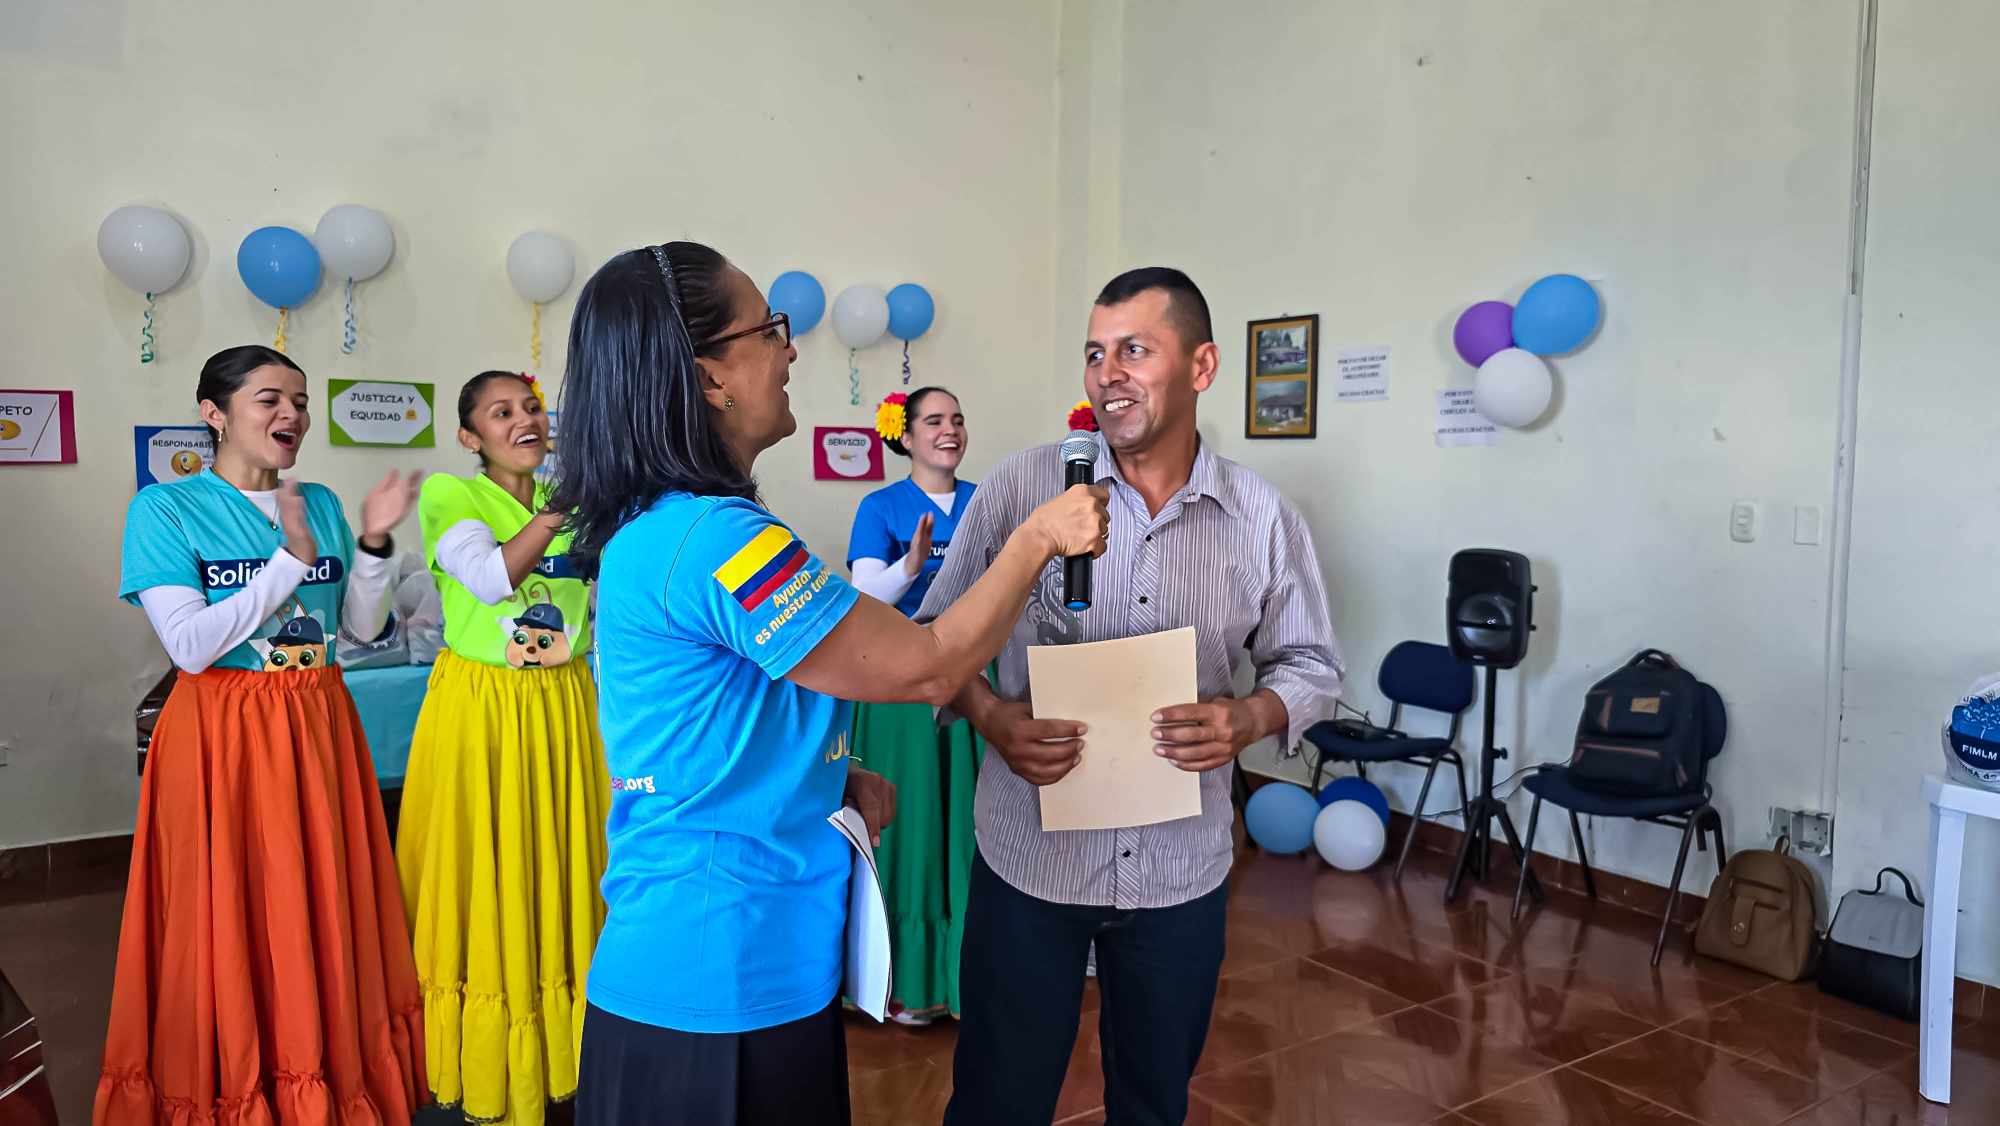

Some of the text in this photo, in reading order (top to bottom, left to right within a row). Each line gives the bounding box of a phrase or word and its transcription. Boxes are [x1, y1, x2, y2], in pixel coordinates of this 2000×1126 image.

[350, 392, 415, 405] JUSTICIA Y
[350, 410, 402, 422] EQUIDAD
[755, 628, 772, 645] es
[769, 590, 813, 632] nuestro
[1962, 744, 1998, 760] FIMLM
